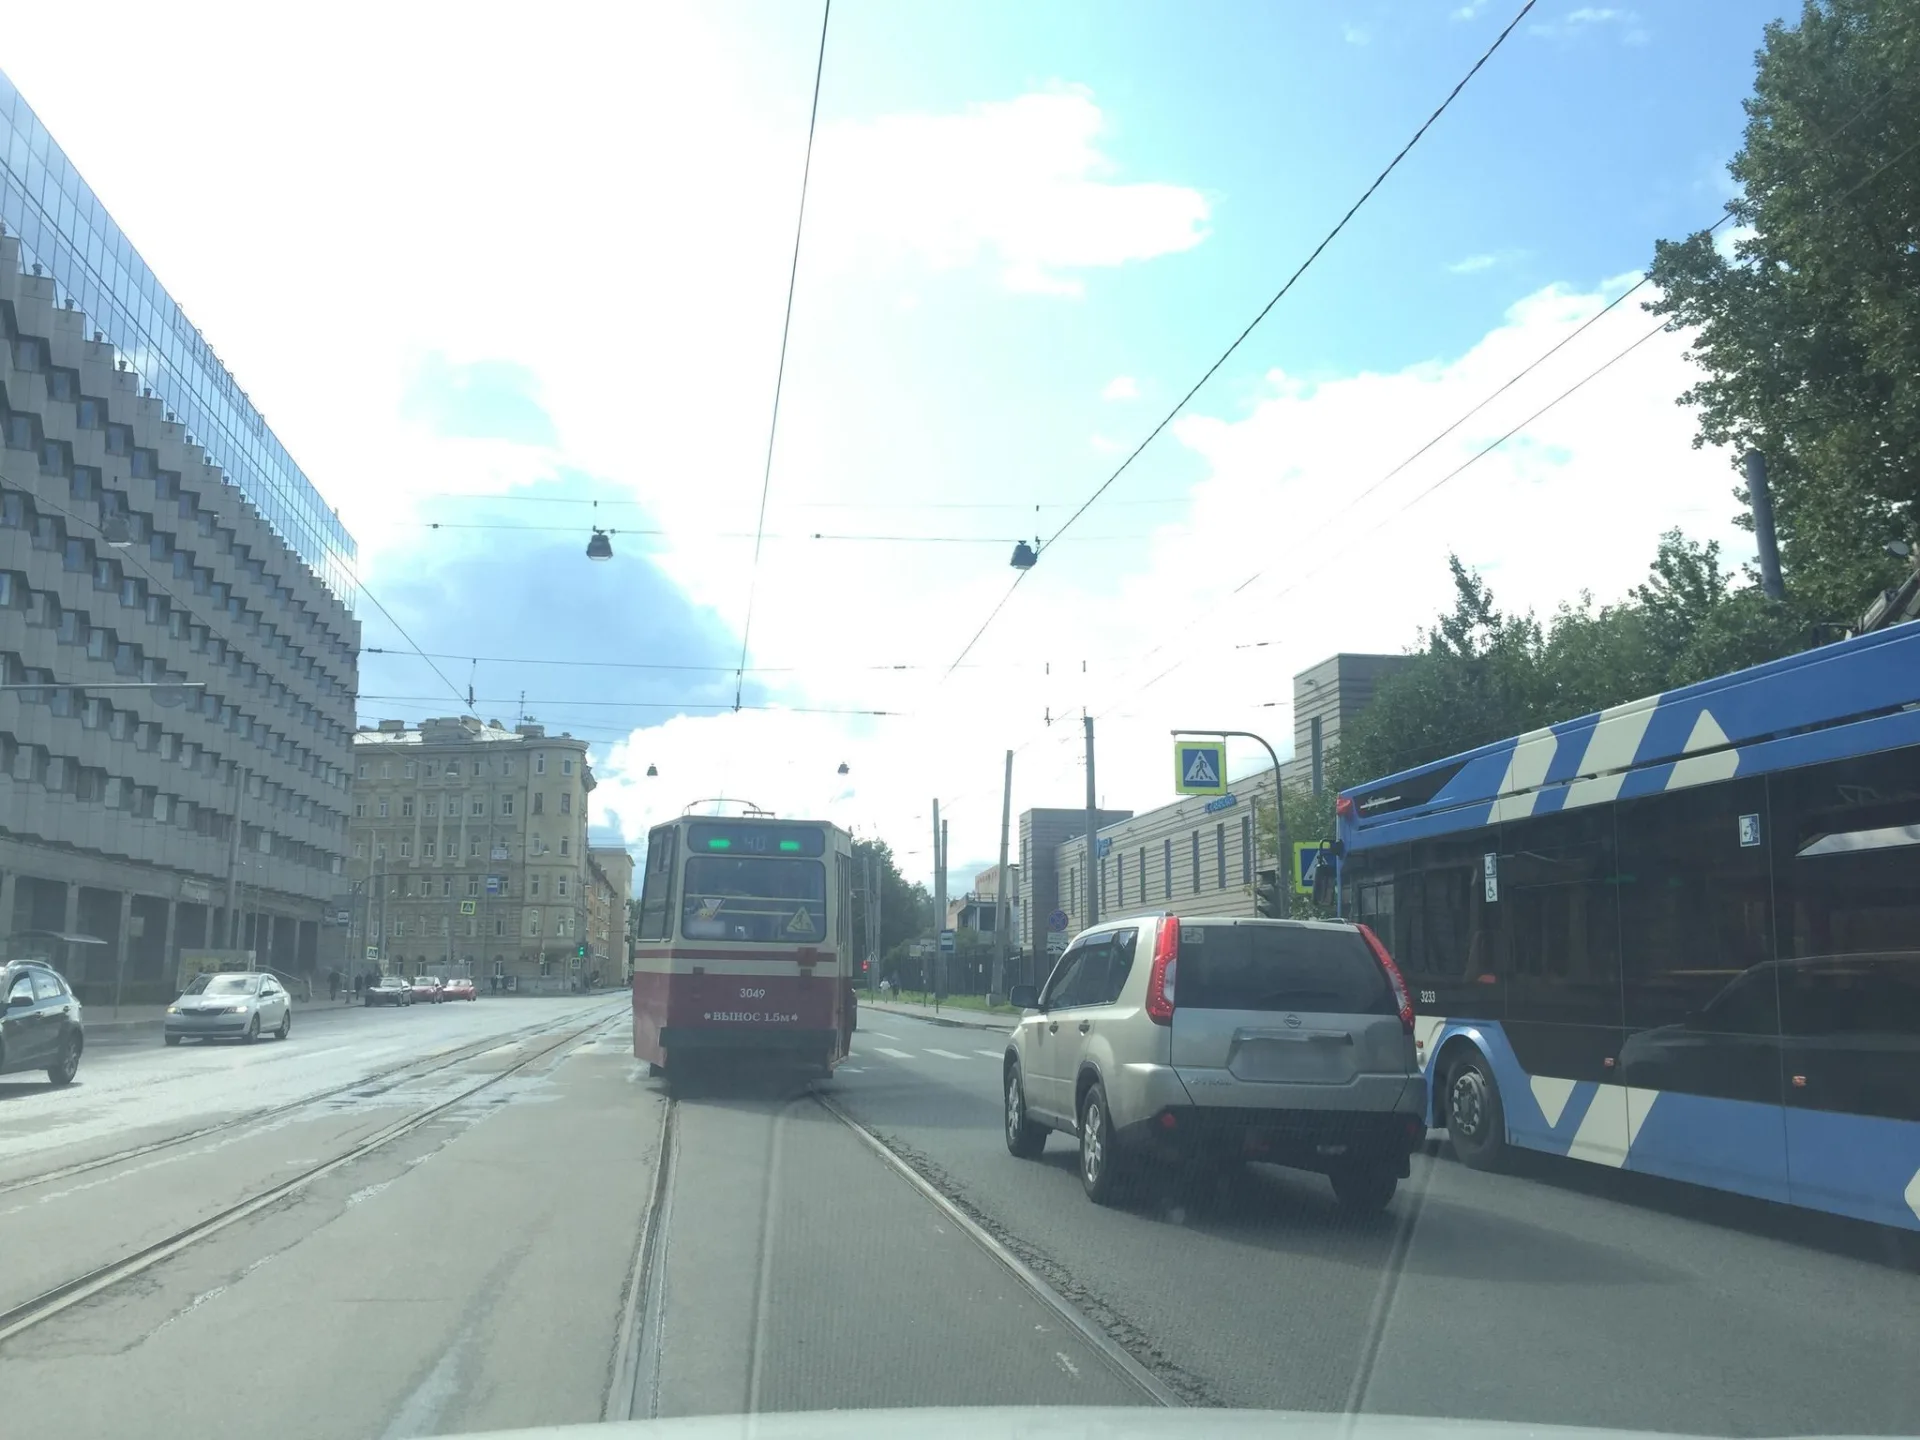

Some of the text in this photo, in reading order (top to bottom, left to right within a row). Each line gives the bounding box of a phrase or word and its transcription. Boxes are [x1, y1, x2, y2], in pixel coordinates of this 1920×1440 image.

[739, 988, 766, 999] 3049
[1420, 990, 1436, 1003] 3233
[712, 1011, 761, 1022] ВЫНОС
